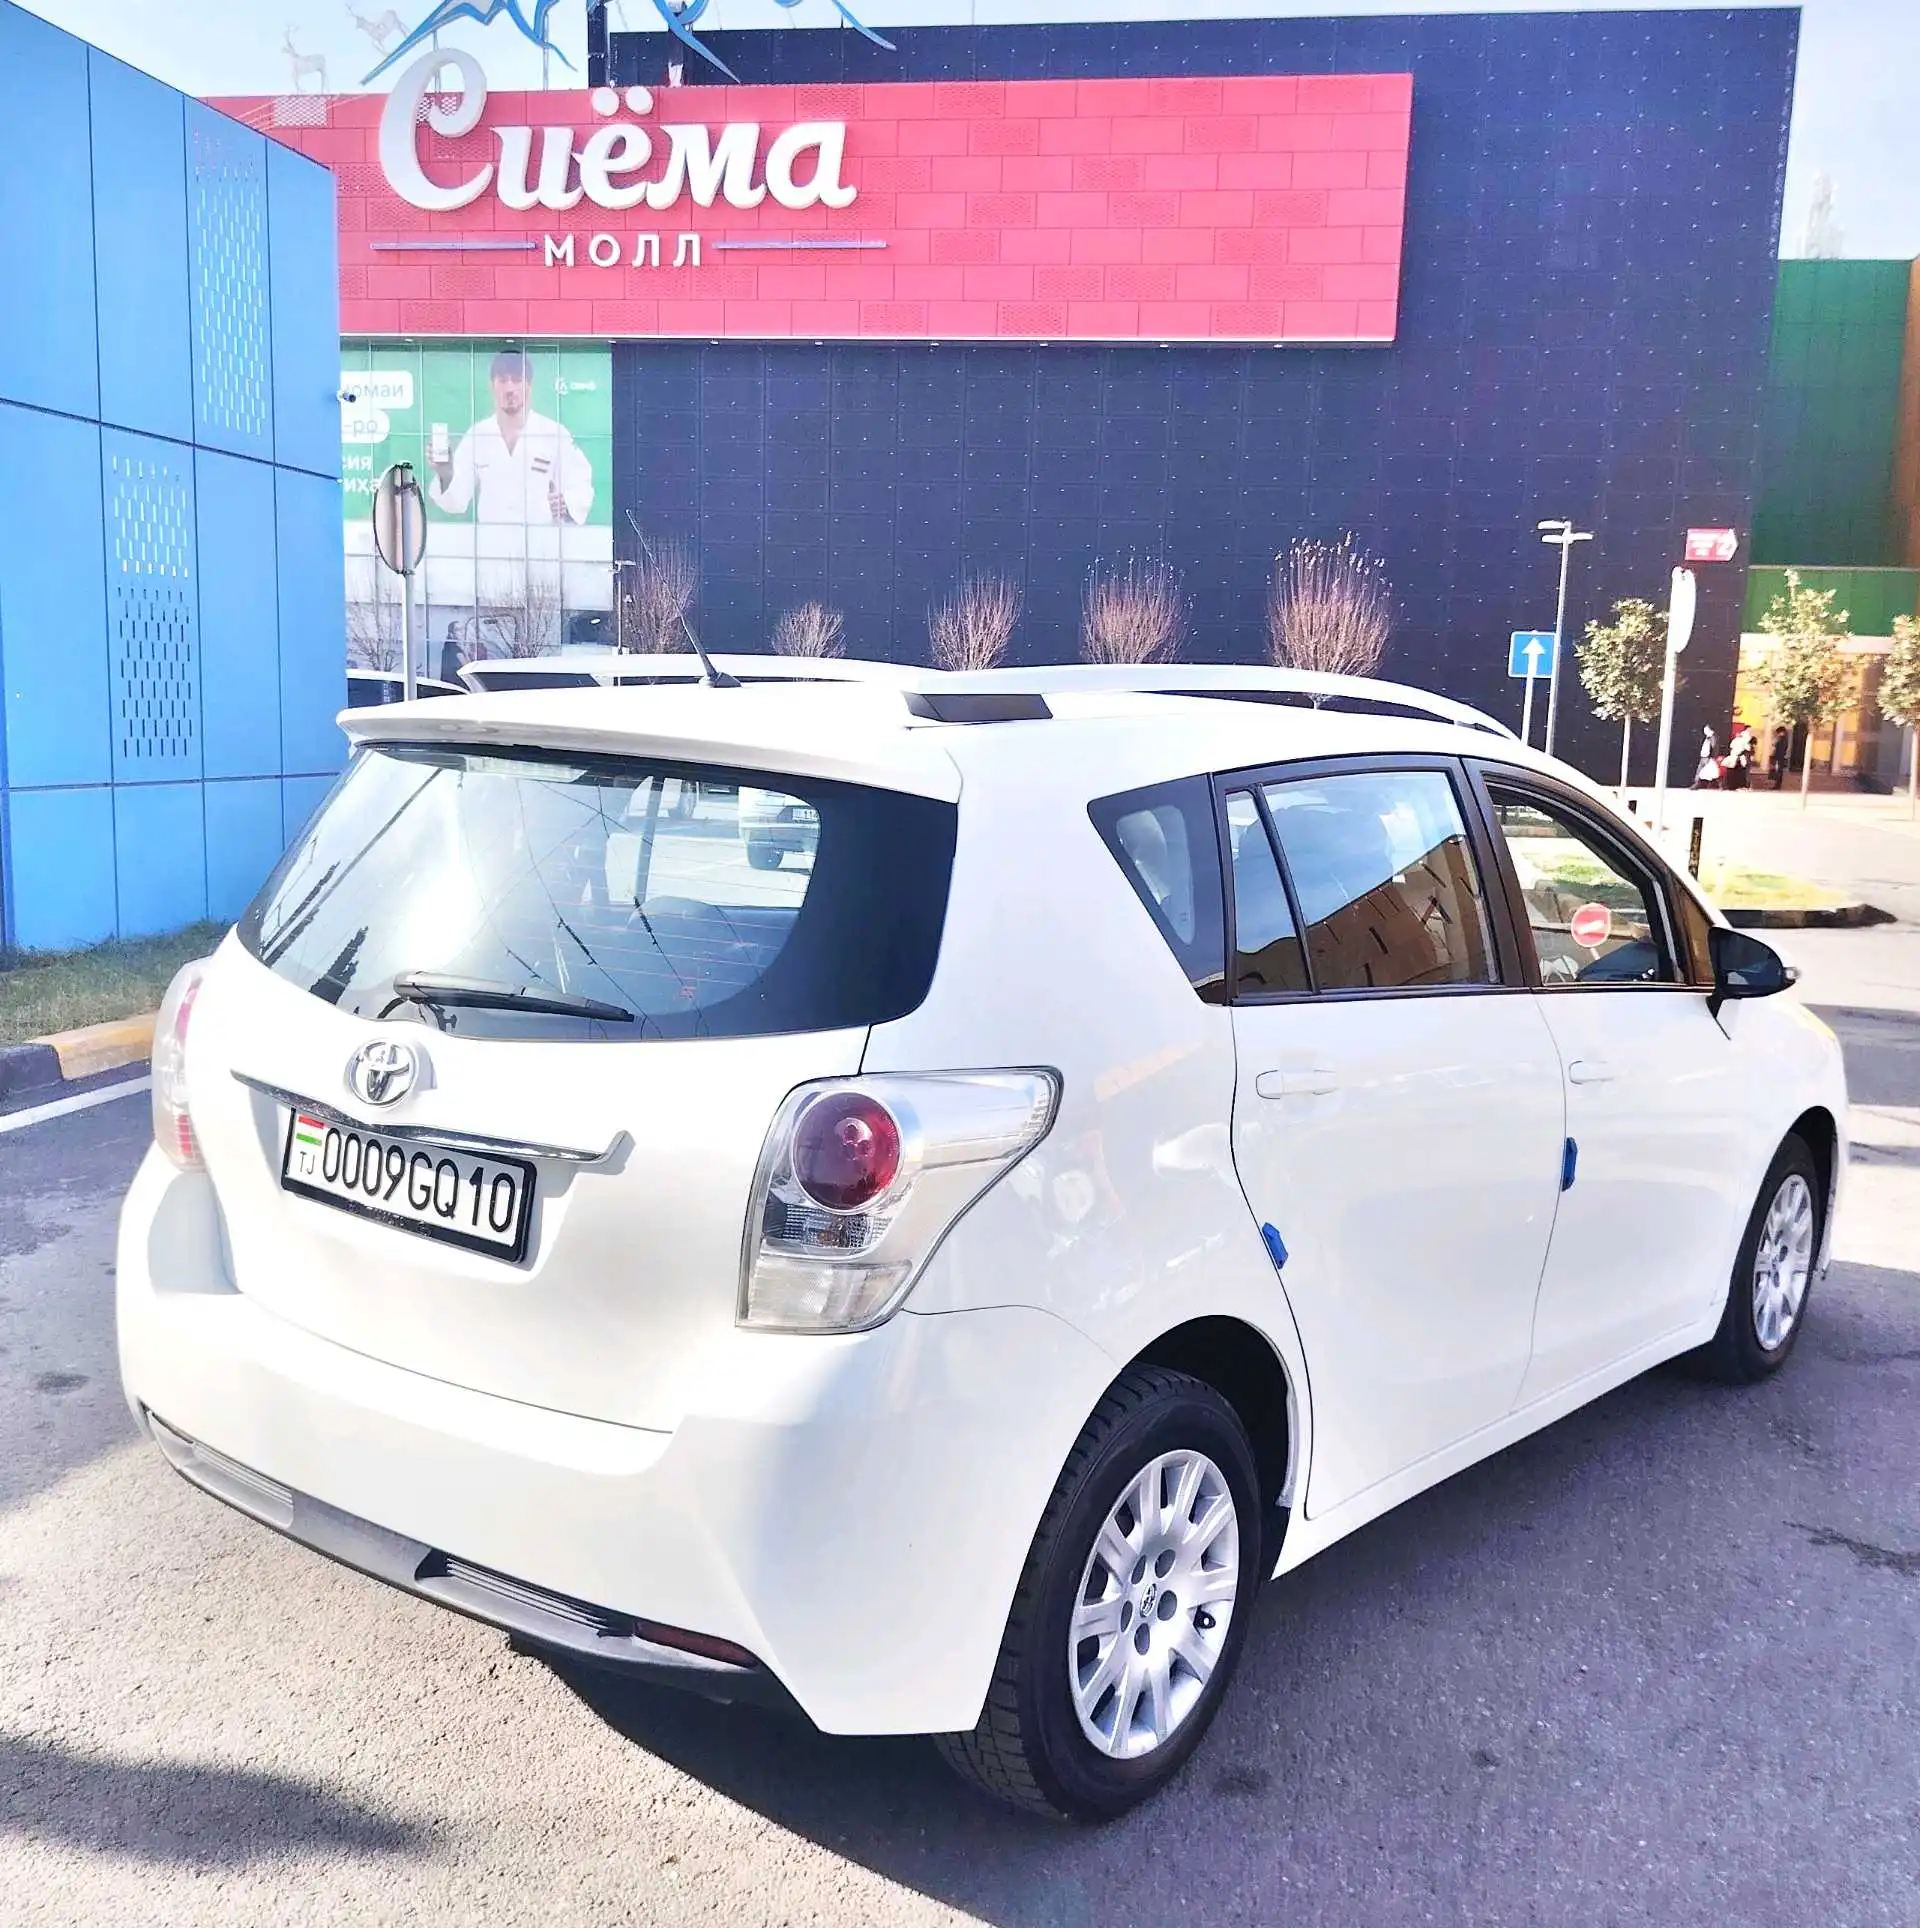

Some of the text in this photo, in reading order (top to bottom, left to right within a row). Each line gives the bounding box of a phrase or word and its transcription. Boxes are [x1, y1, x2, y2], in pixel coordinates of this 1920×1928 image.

[378, 46, 859, 213] Сиёма
[543, 234, 702, 269] МОЛЛ
[299, 1151, 316, 1176] TJ
